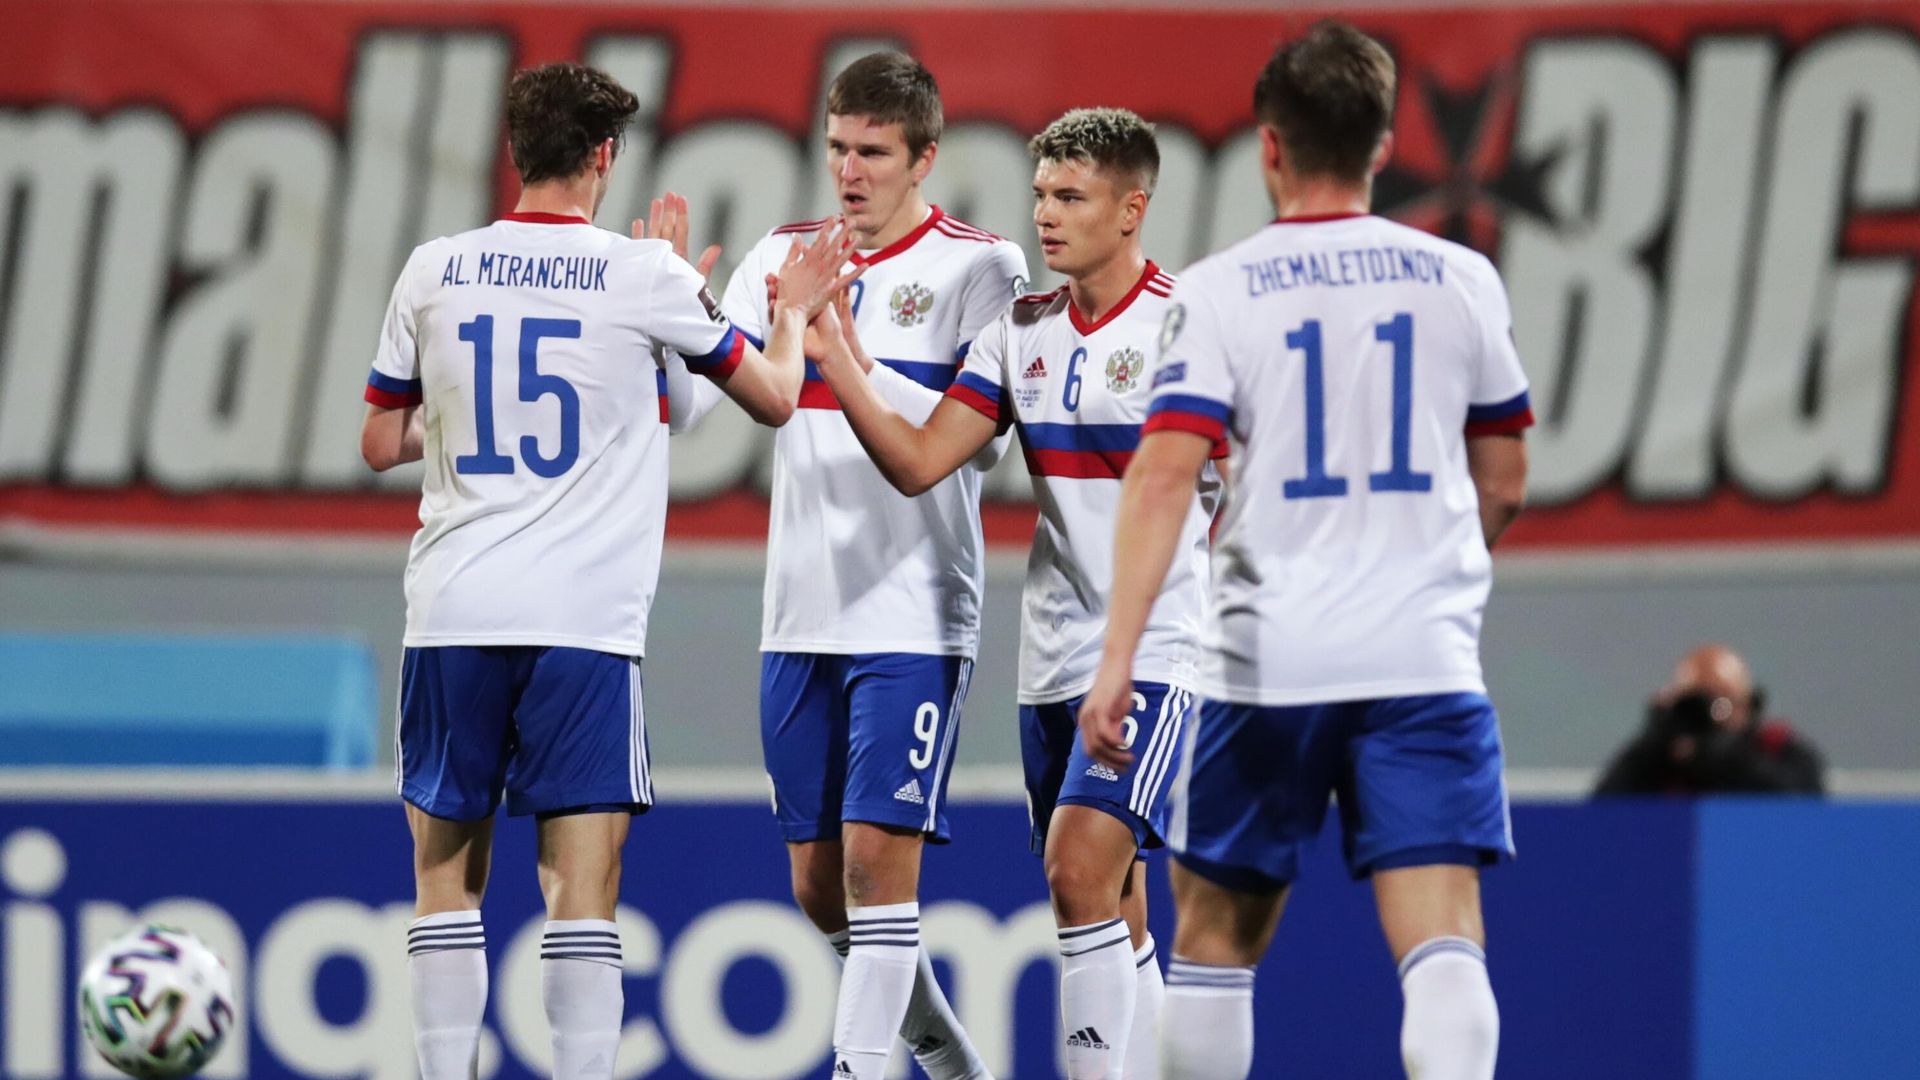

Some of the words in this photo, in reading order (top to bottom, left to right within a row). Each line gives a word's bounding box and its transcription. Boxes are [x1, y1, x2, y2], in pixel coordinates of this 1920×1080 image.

[441, 253, 470, 287] AL.
[477, 251, 609, 292] MIRANCHUK
[1240, 246, 1446, 298] ZHEMALETDINOV
[1500, 26, 1920, 500] BIG
[456, 314, 582, 479] 15
[1062, 346, 1088, 413] 6
[1283, 312, 1433, 500] 11
[908, 701, 940, 770] 9
[1065, 1038, 1111, 1051] adidas
